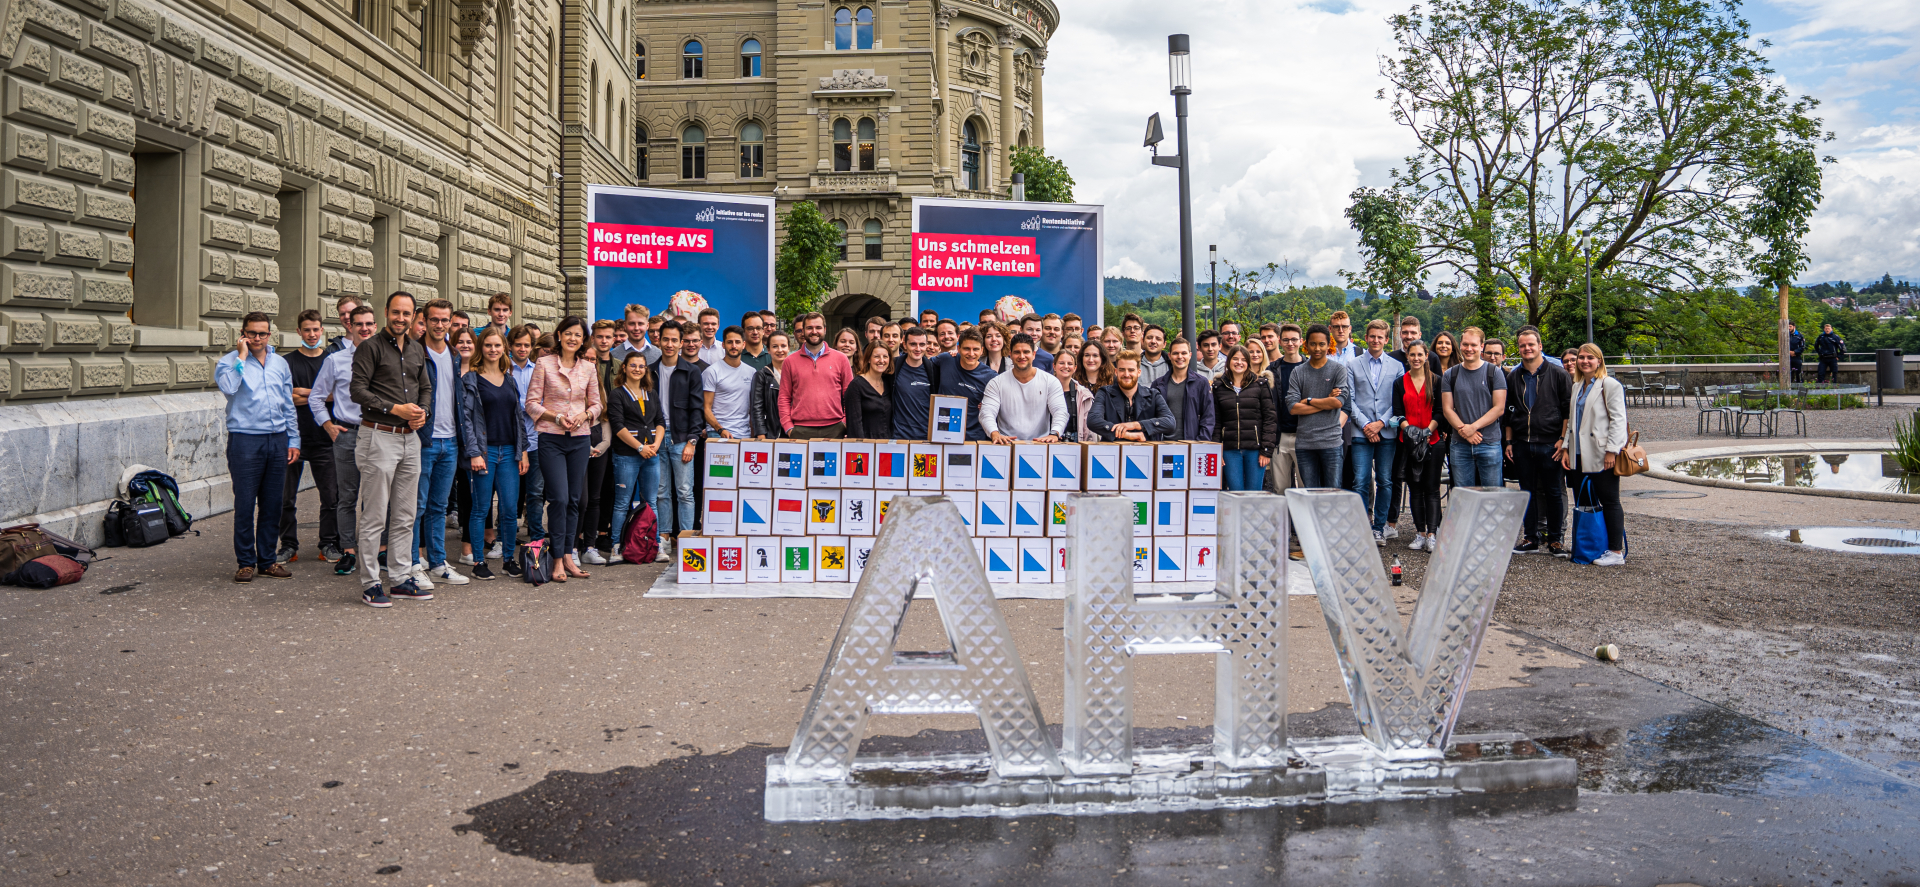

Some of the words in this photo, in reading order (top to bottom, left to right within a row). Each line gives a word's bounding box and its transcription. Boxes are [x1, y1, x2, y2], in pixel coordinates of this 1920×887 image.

[1041, 217, 1086, 226] Renteninitiative
[593, 228, 622, 244] Nos
[626, 232, 674, 247] rentes
[677, 233, 707, 248] AVS
[918, 237, 947, 252] Uns
[951, 239, 1030, 255] schmelzen
[593, 246, 653, 264] fondent
[656, 250, 662, 264] !
[918, 255, 942, 269] die
[945, 256, 1035, 273] AHV-Renten
[918, 273, 968, 288] davon!
[784, 487, 1530, 782] AHV
